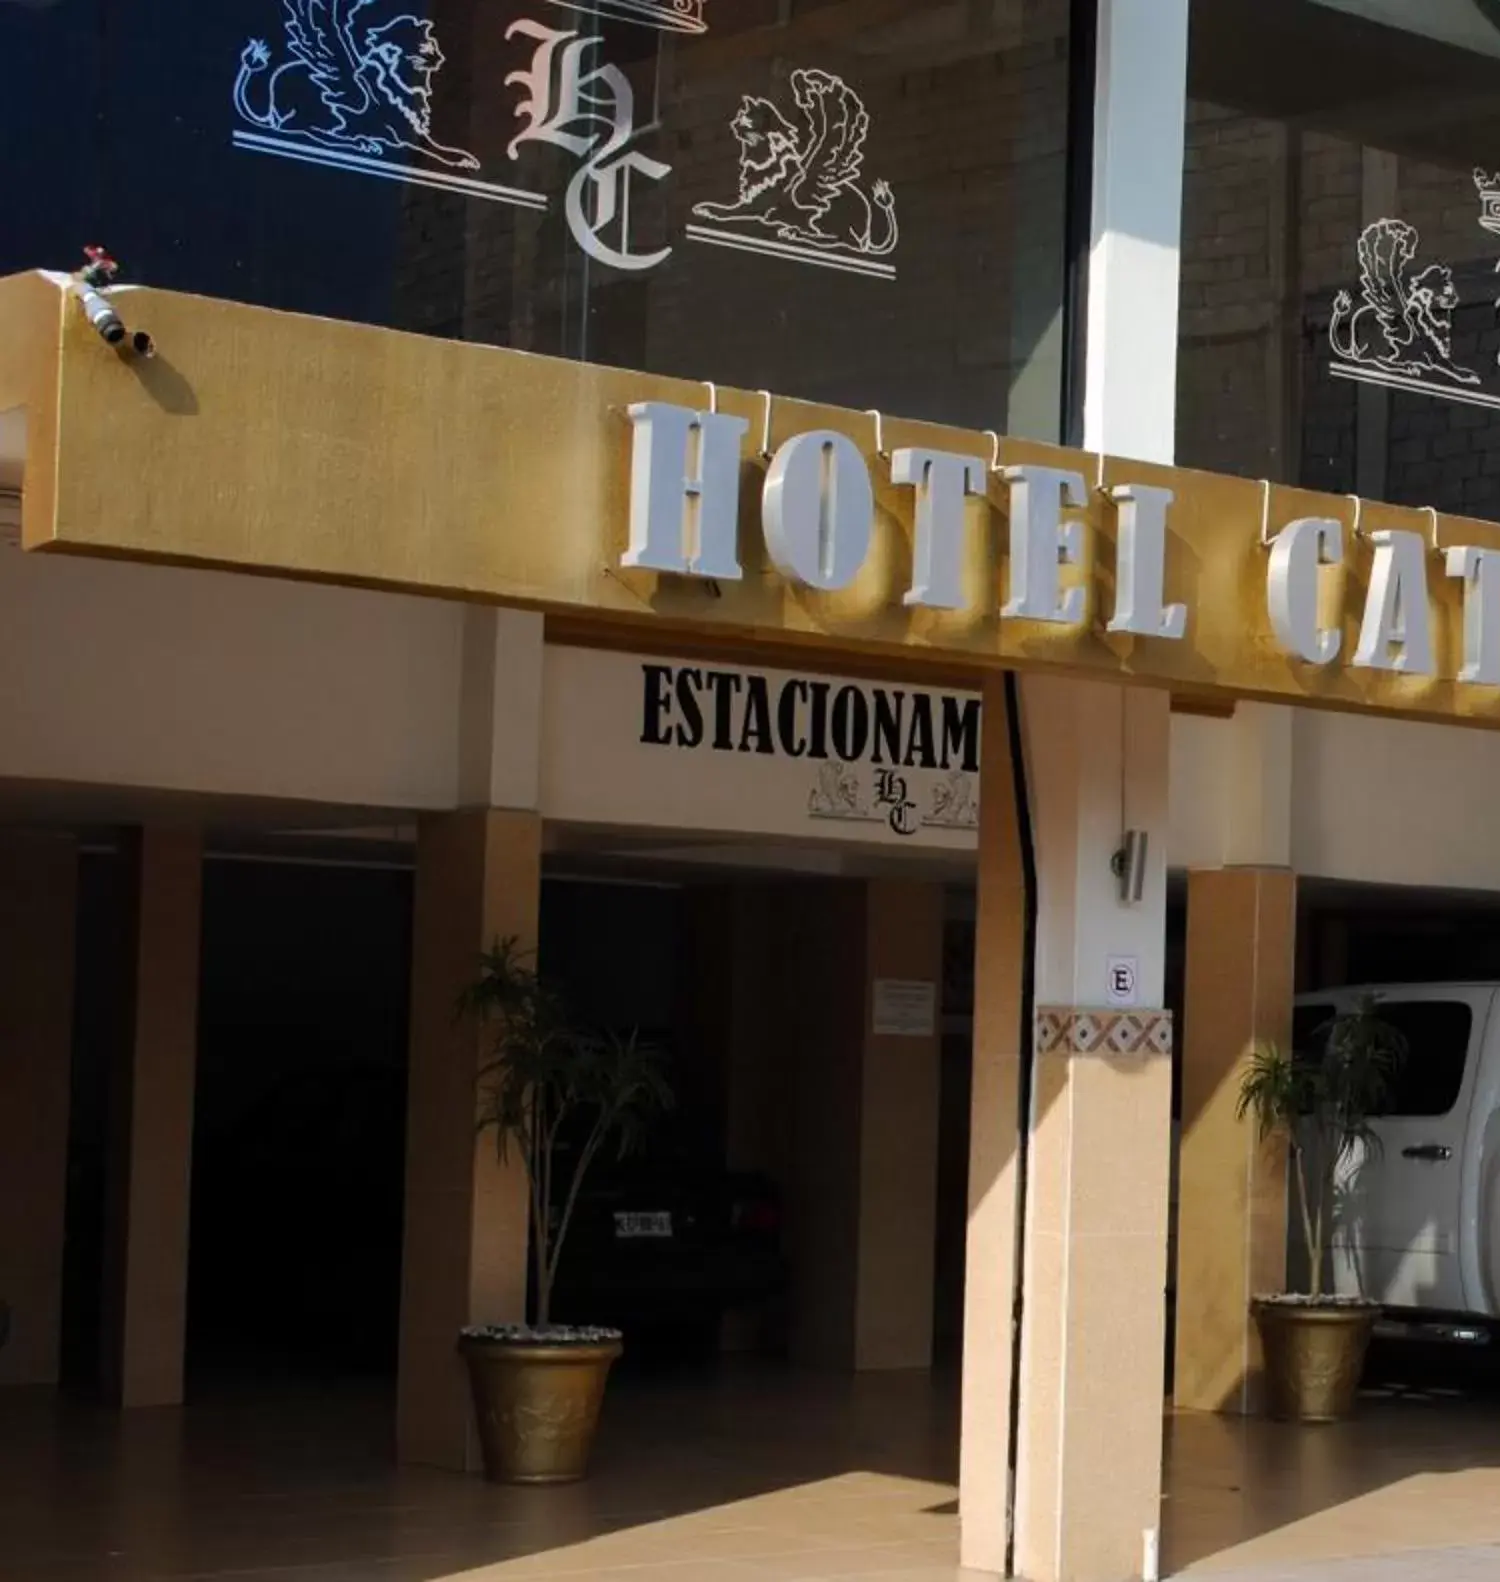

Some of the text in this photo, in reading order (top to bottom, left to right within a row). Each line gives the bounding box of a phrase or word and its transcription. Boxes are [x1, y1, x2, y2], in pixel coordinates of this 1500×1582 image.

[620, 402, 1187, 640] HOTEL
[640, 664, 982, 773] ESTACIONAM
[1115, 969, 1129, 991] E
